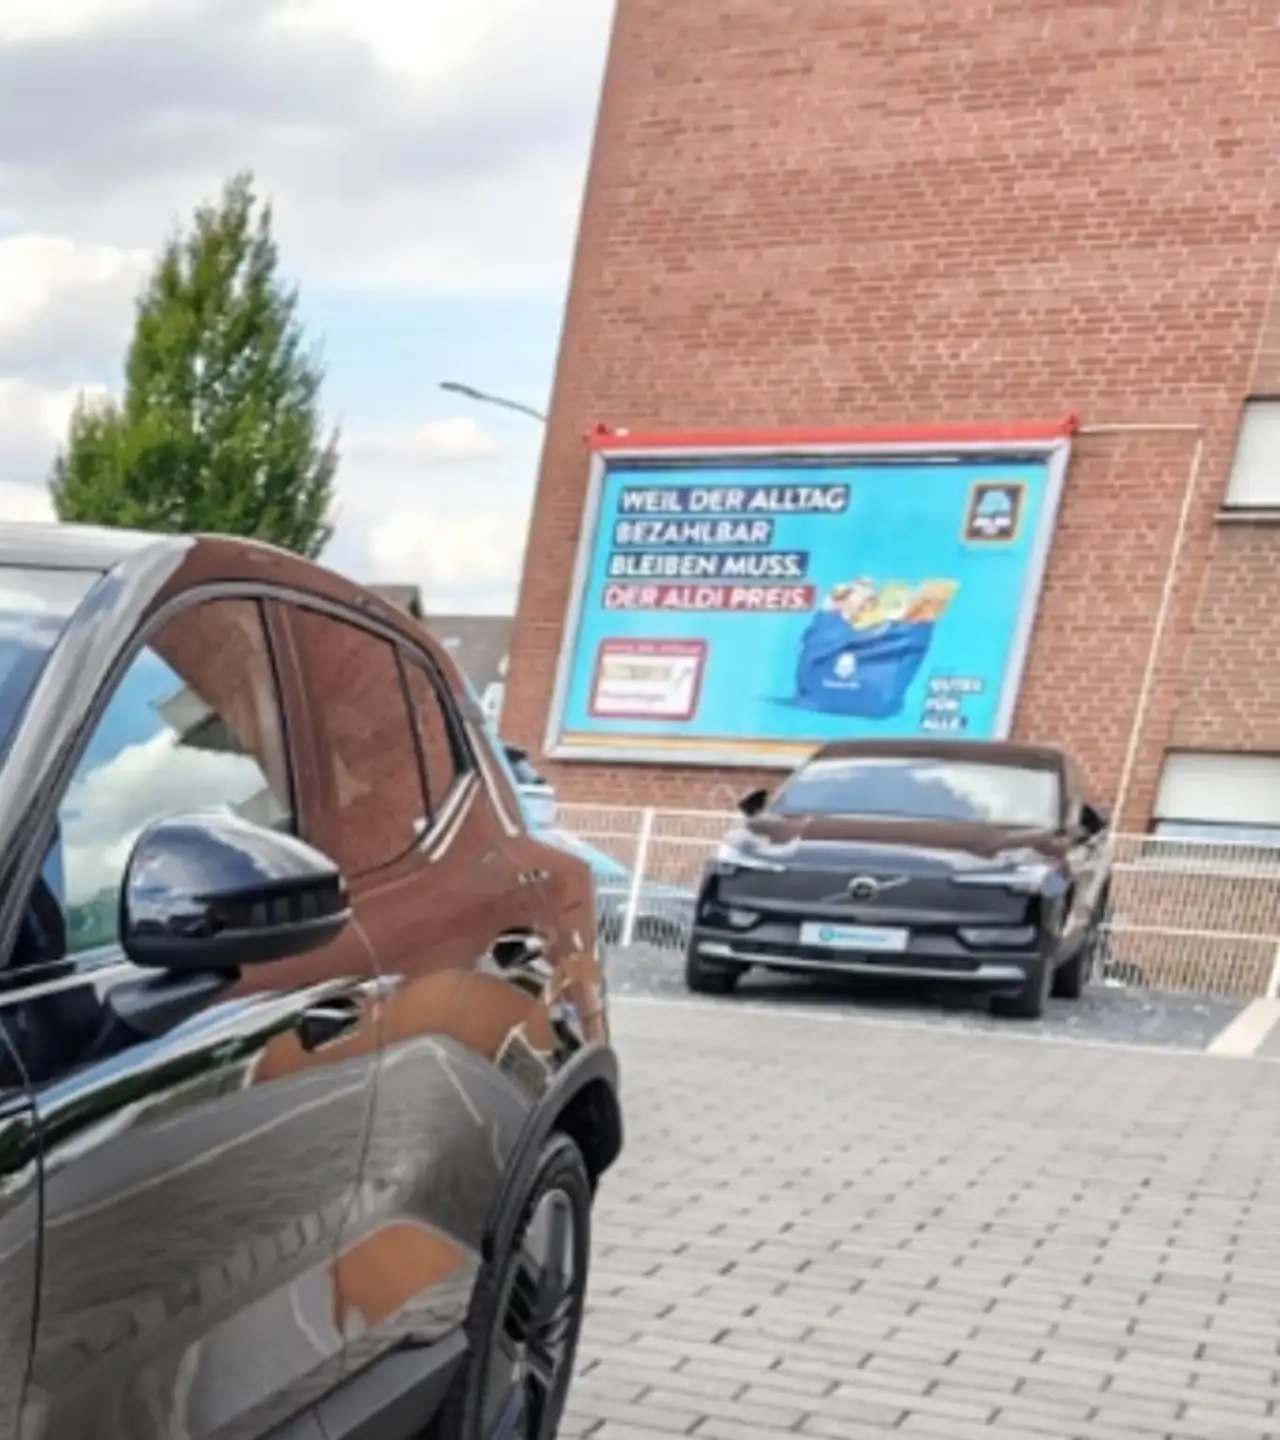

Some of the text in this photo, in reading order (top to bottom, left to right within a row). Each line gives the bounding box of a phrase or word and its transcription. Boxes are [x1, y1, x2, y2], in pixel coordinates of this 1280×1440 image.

[622, 487, 846, 512] WEIL DER ALLTAG
[615, 520, 772, 544] BEZAHLBAR
[610, 553, 803, 576] BLEIBEN MUSS.
[604, 586, 659, 610] DER
[661, 586, 724, 610] ALDI
